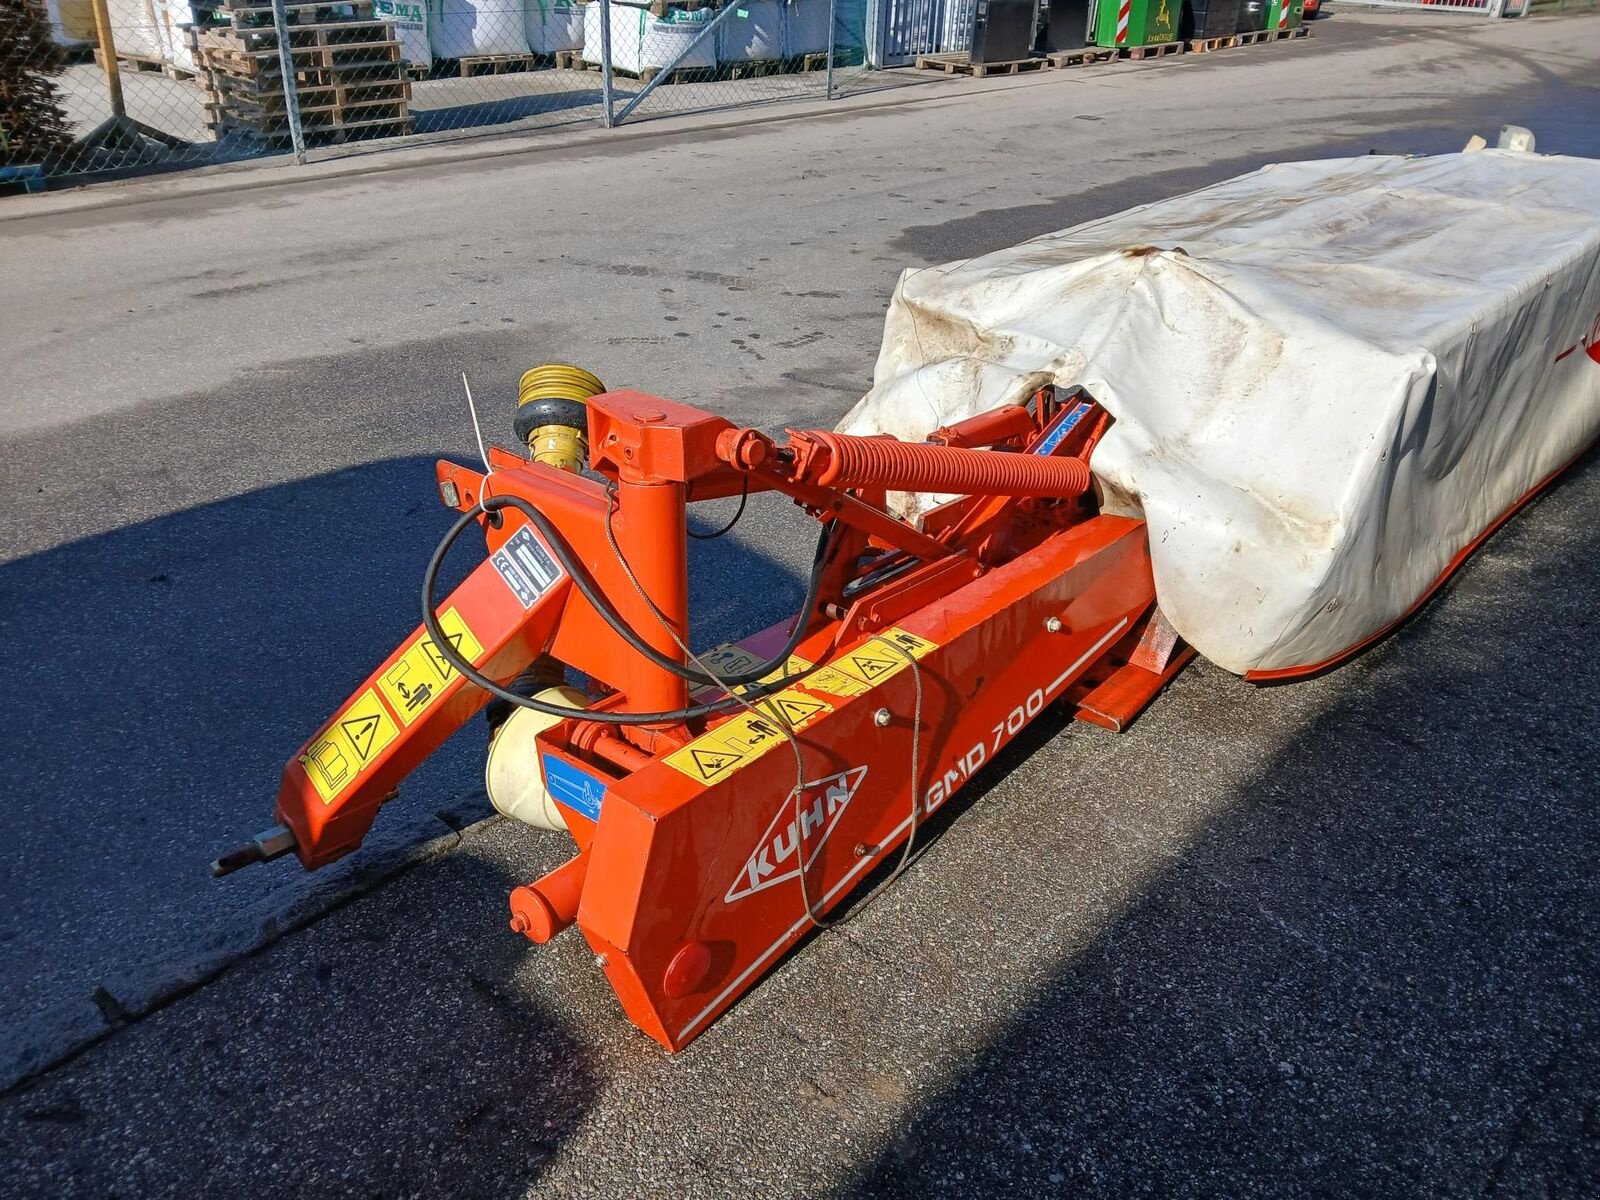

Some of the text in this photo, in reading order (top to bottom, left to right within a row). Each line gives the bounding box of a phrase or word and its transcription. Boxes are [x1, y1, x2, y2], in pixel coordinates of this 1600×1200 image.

[925, 688, 1043, 813] GMD 700
[747, 773, 848, 889] KUHN
